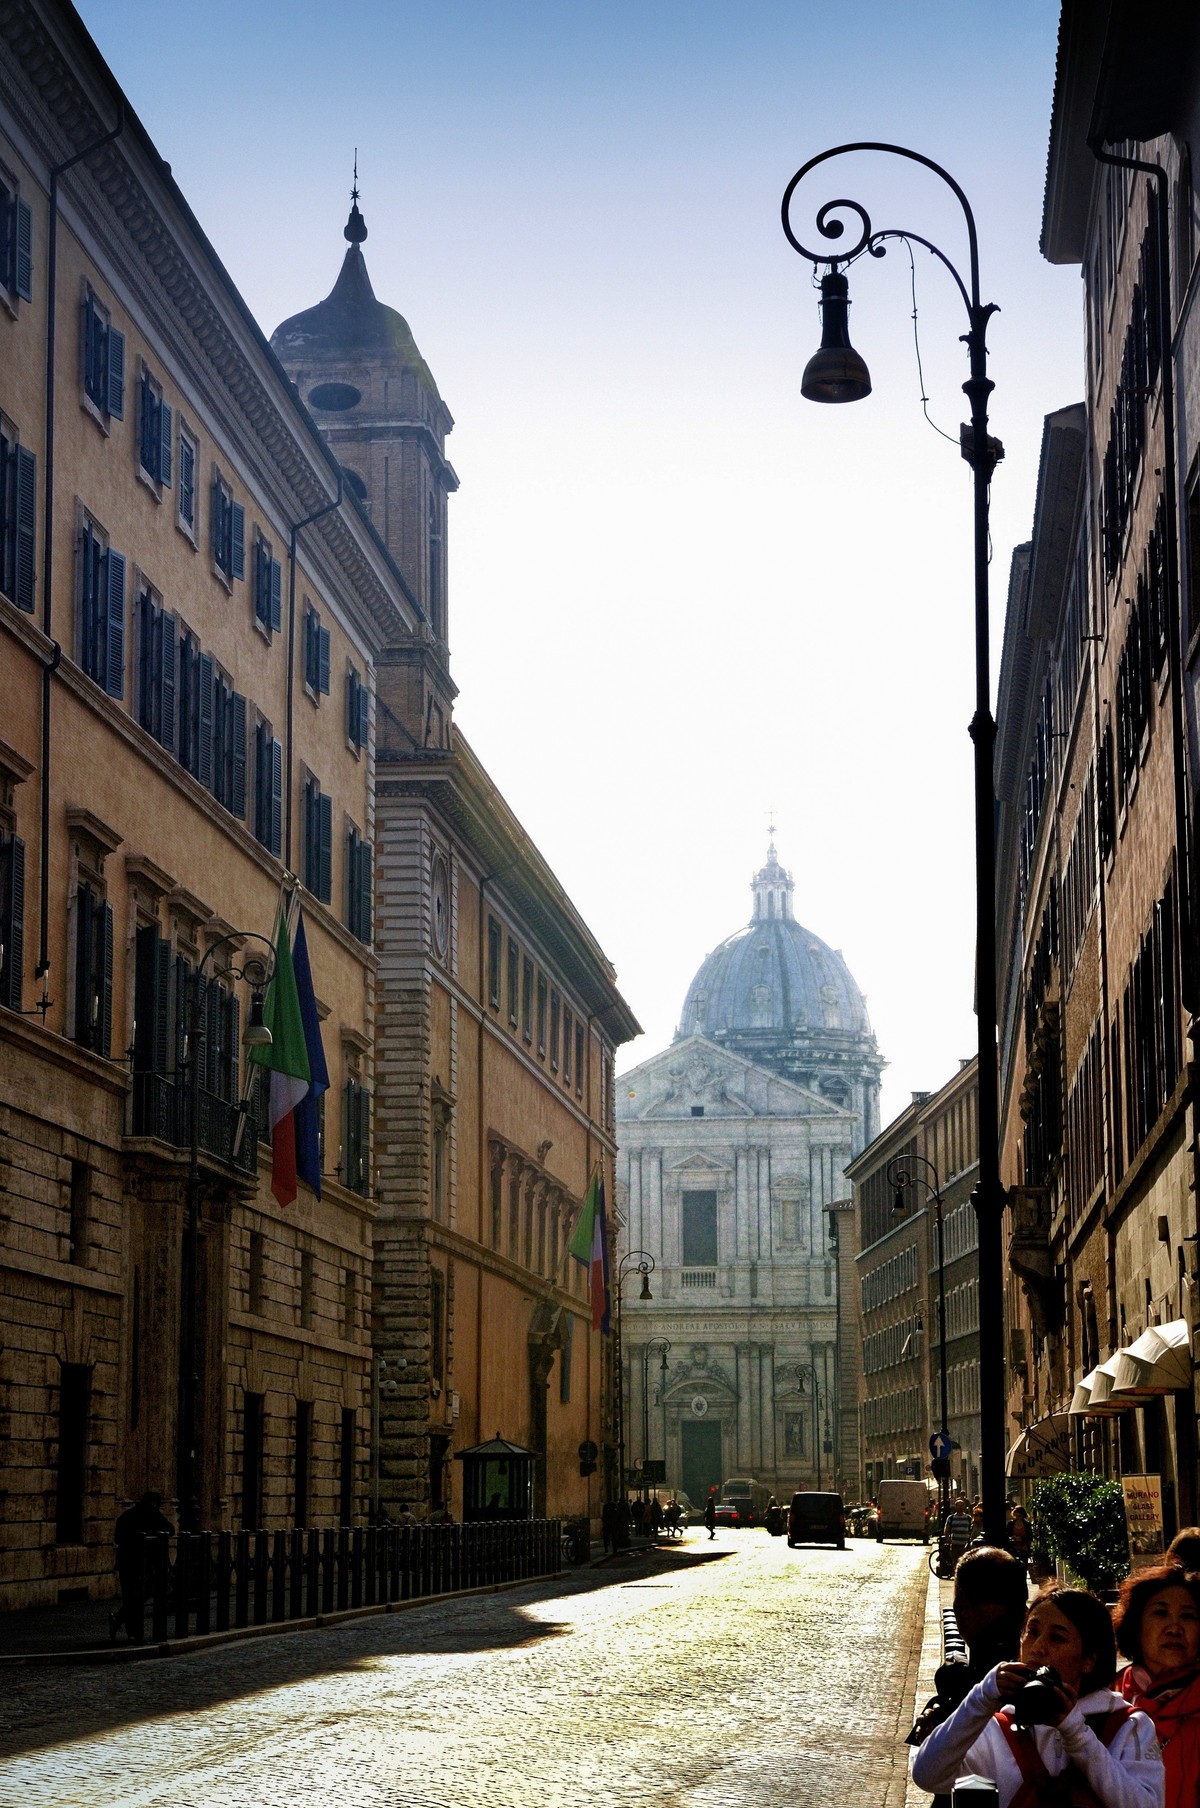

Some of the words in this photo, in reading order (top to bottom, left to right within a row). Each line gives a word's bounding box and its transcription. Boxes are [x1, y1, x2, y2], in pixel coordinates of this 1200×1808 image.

[1017, 1431, 1067, 1474] MURANO
[907, 1467, 913, 1475] P
[1127, 1491, 1159, 1499] MURANO
[1130, 1513, 1160, 1521] GALLERY
